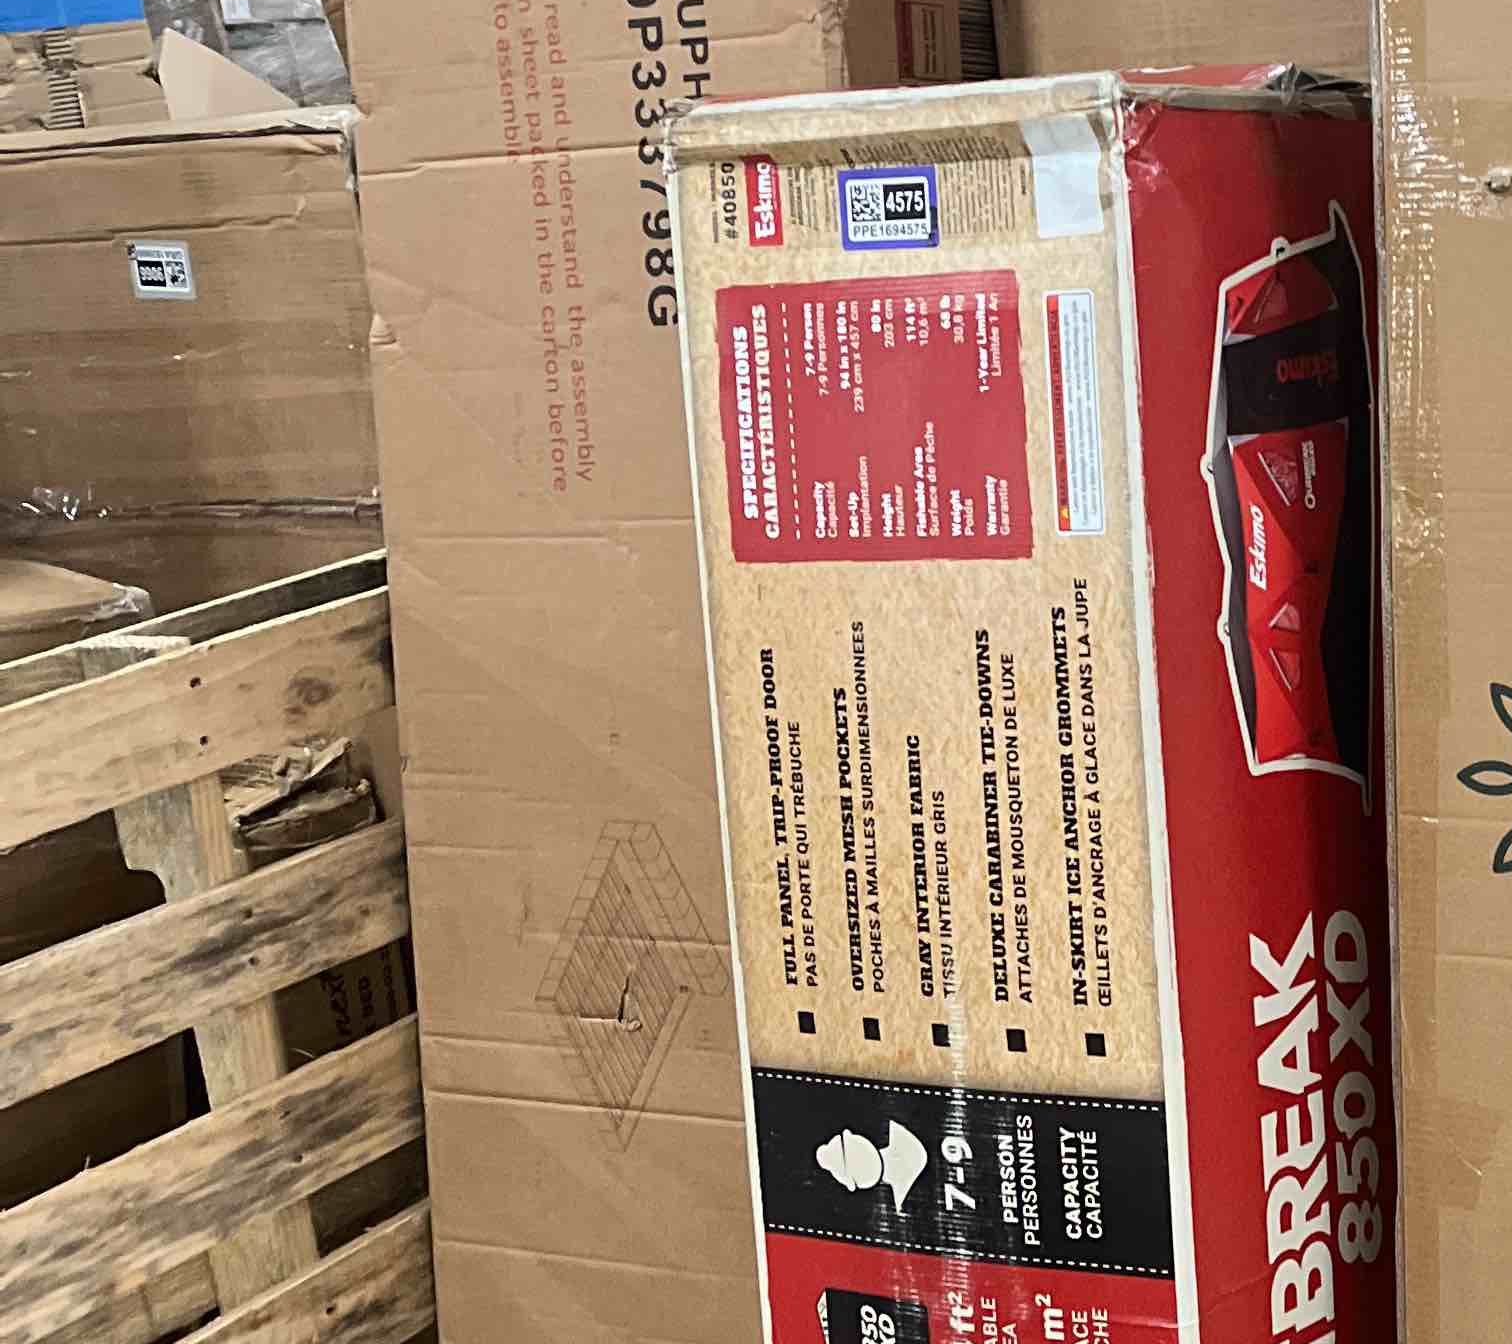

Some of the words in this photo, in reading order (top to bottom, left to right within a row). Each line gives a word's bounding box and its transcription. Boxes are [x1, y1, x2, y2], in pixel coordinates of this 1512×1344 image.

[494, 4, 511, 30] to
[544, 3, 566, 64] read
[520, 27, 540, 101] sheet
[551, 76, 572, 126] and
[524, 111, 552, 208] packed
[555, 137, 584, 289] understand
[721, 162, 738, 239] #40850
[753, 162, 776, 239] Eskimo
[886, 191, 924, 213] 4575
[535, 217, 553, 241] in
[852, 224, 929, 239] PPE1694575
[537, 253, 556, 295] the
[567, 305, 587, 347] the
[803, 303, 814, 349] Person
[837, 301, 846, 314] in
[849, 300, 858, 321] cm
[884, 299, 894, 319] cm
[884, 323, 895, 348] 203
[906, 316, 916, 342] 114
[941, 312, 951, 329] 68
[975, 293, 987, 344] Limited
[541, 306, 561, 393] carton
[806, 353, 815, 376] 7-9
[816, 303, 827, 371] Personnes
[839, 356, 849, 368] in
[850, 324, 860, 349] 457
[819, 375, 829, 396] 7-9
[841, 372, 850, 389] 94
[853, 364, 862, 384] cm
[977, 347, 990, 392] 1-Year
[570, 360, 595, 482] assembly
[733, 326, 759, 519] SPECIFICATIONS
[752, 304, 779, 539] CARACTÉRISTIQUES
[854, 387, 864, 413] 239
[548, 404, 569, 492] before
[913, 447, 924, 477] Area
[926, 466, 937, 482] de
[814, 482, 826, 538] Capacity
[848, 491, 860, 537] Set-Up
[858, 456, 872, 537] Implantation
[881, 493, 894, 537] Height
[915, 481, 928, 537] Fishable
[927, 485, 940, 537] Surface
[950, 489, 963, 536] Weight
[964, 498, 975, 536] Poids
[985, 475, 998, 536] Warranty
[999, 479, 1010, 536] Garantie
[1248, 503, 1267, 591] Eskimo
[1074, 578, 1089, 628] JUPE
[1077, 634, 1092, 658] LA
[760, 648, 777, 710] DOOR
[975, 629, 996, 765] TIE-DOWNS
[1000, 654, 1015, 701] LUXE
[1051, 606, 1073, 746] GROMMETS
[1079, 664, 1095, 716] DANS
[833, 687, 851, 789] POCKETS
[1003, 706, 1018, 730] DE
[765, 716, 788, 846] TRIP-PROOF
[787, 721, 806, 817] TRÉBUCHE
[906, 735, 922, 815] FABRIC
[1082, 721, 1100, 785] GLACE
[931, 790, 946, 834] GRIS
[1004, 736, 1025, 869] MOUSQUETON
[1059, 753, 1079, 851] ANCHOR
[1083, 790, 1100, 803] À
[794, 823, 809, 855] QUI
[838, 796, 857, 863] MESH
[862, 817, 879, 896] MAILLES
[983, 770, 1004, 907] CARABINER
[797, 860, 813, 919] PORTE
[911, 821, 930, 933] INTERIOR
[933, 840, 953, 937] INTÉRIEUR
[1013, 875, 1027, 897] DE
[1066, 857, 1082, 895] ICE
[801, 924, 815, 947] DE
[844, 869, 864, 992] OVERSIZED
[865, 901, 879, 914] À
[783, 934, 798, 985] FULL
[801, 952, 818, 987] PAS
[868, 919, 885, 992] POCHES
[918, 938, 934, 997] GRAY
[941, 942, 958, 998] TISSU
[990, 912, 1009, 1002] DELUXE
[1015, 904, 1033, 1003] ATTACHES
[1069, 900, 1089, 1006] IN-SKIRT
[1324, 909, 1383, 1264] 850XD
[941, 1135, 976, 1211] 7-9
[997, 1134, 1019, 1223] PERSON
[1016, 1115, 1040, 1245] PERSONNES
[1060, 1127, 1082, 1239] CAPACITY
[1077, 1131, 1102, 1238] CAPACITÉ
